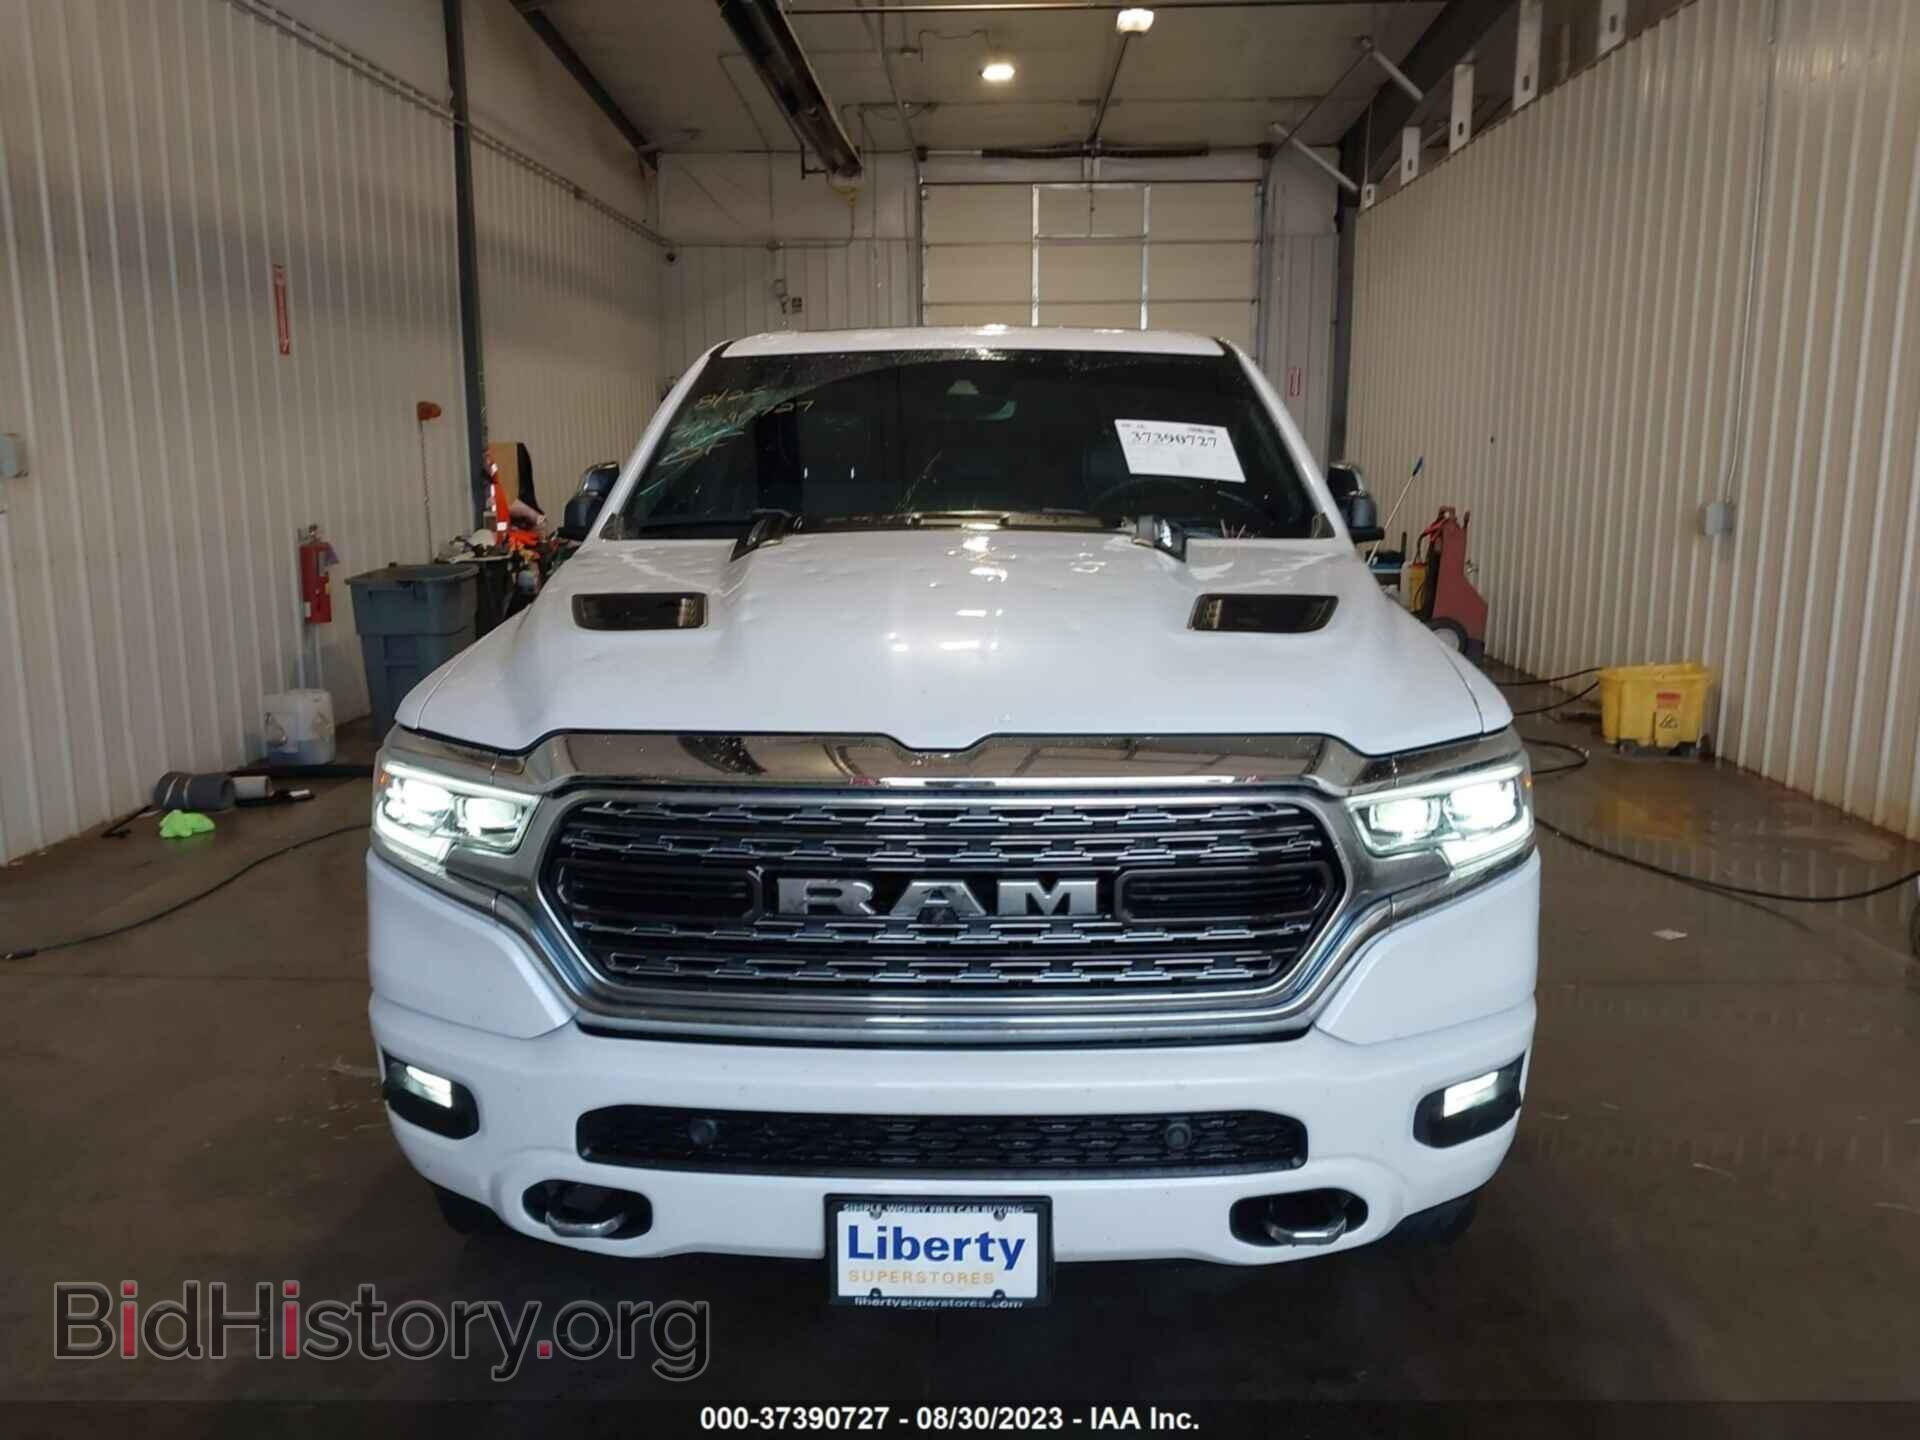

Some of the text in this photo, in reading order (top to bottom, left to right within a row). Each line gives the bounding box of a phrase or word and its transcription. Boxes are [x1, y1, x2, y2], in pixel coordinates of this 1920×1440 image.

[1131, 431, 1217, 448] 37390727
[777, 878, 1098, 916] RAM
[848, 1225, 1026, 1271] Liberty
[848, 1270, 995, 1285] SUPERSTORES
[855, 1297, 1023, 1309] libertysuperstores.com
